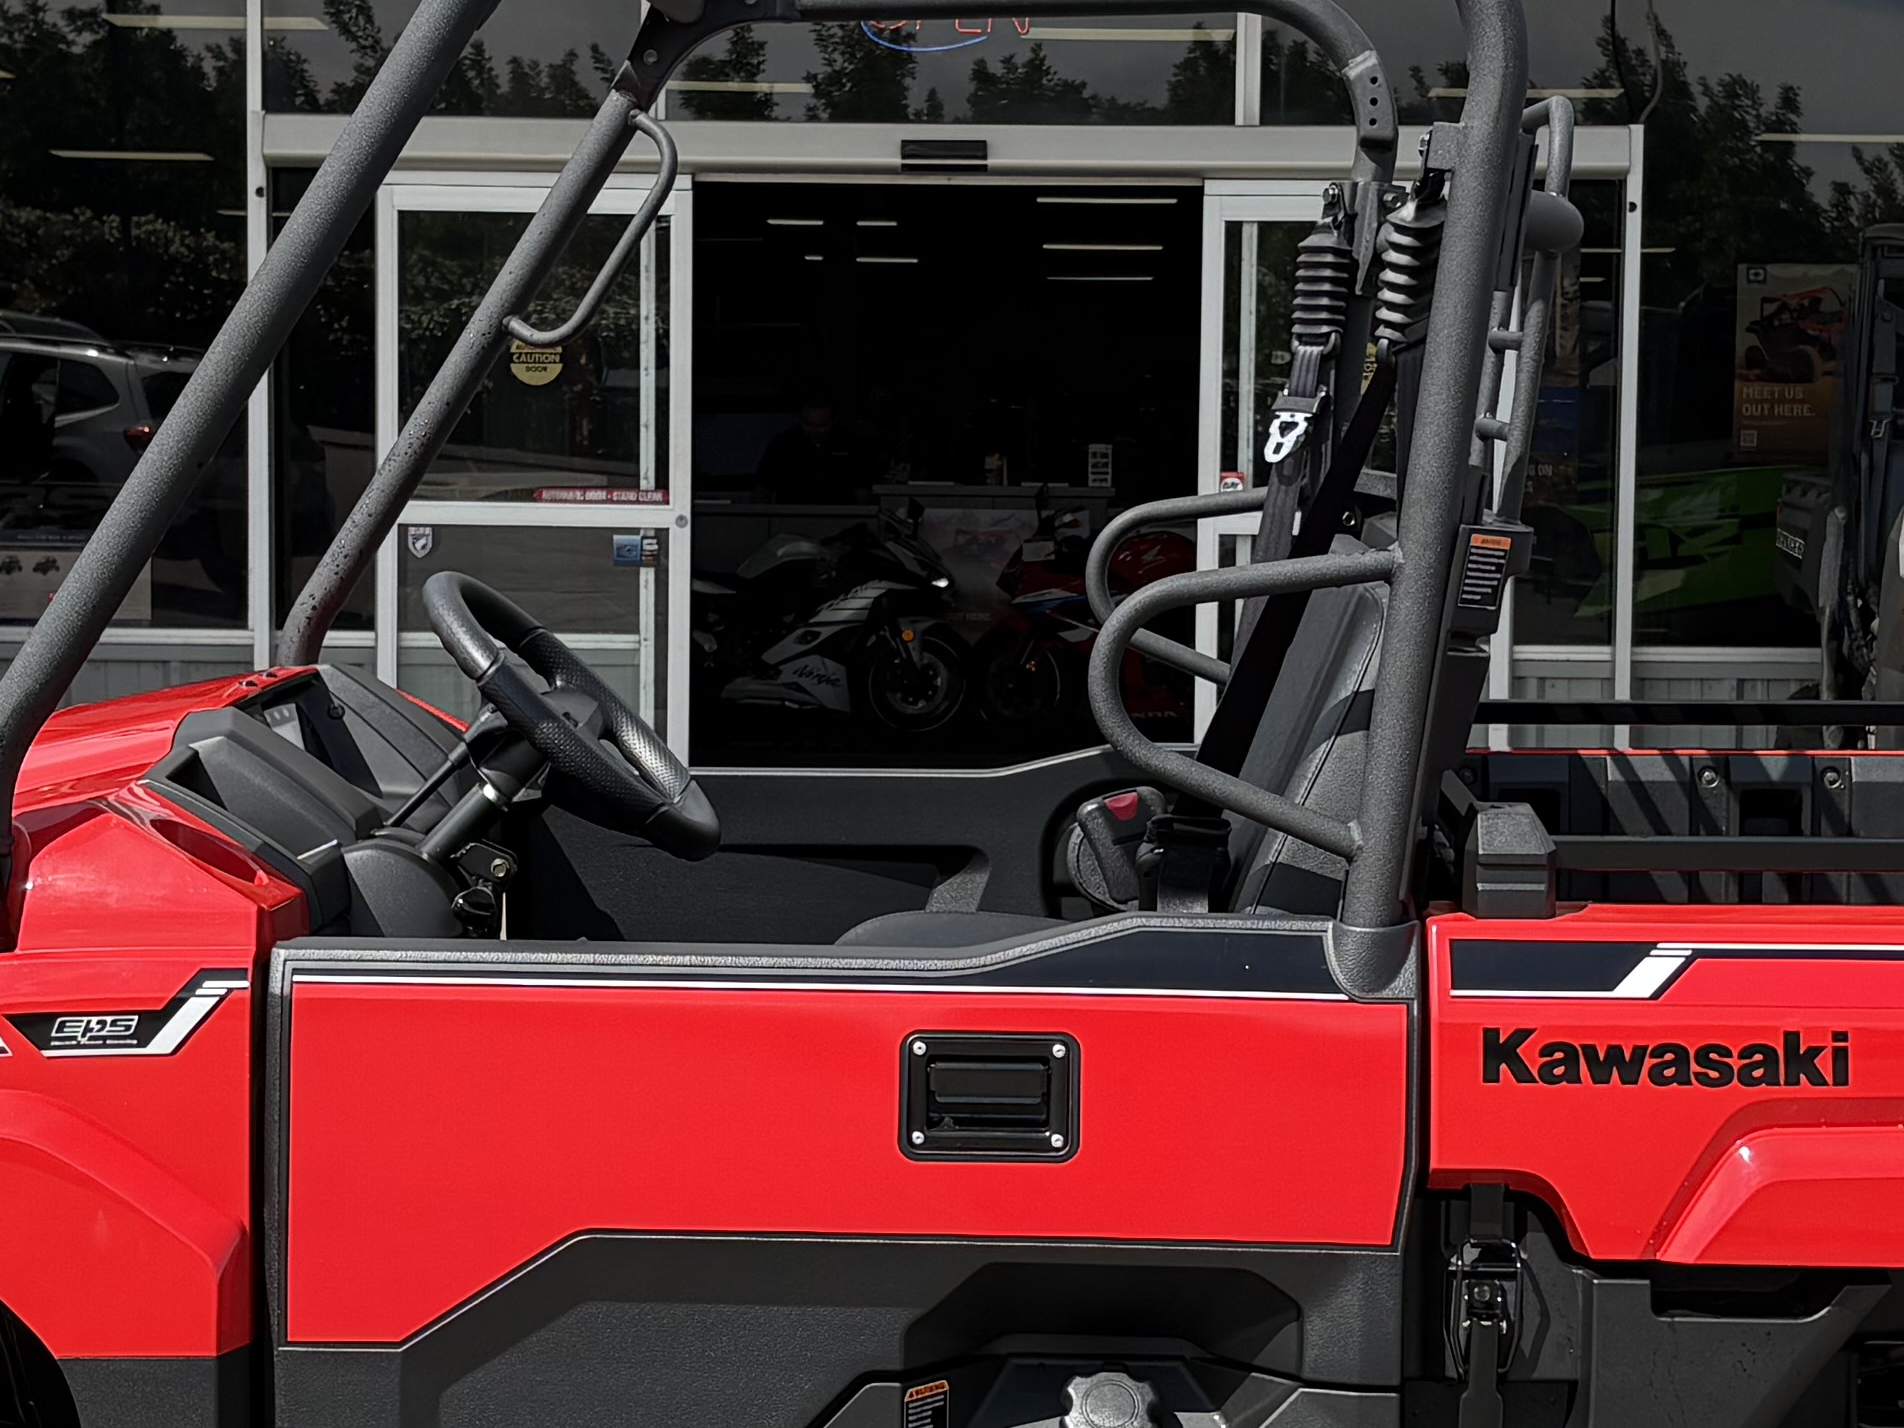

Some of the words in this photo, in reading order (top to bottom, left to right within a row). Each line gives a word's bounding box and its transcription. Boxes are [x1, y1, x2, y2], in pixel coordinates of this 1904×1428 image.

[512, 352, 561, 364] CAUTION
[1742, 386, 1783, 400] MEET
[1784, 386, 1804, 400] US
[1742, 403, 1769, 417] OUT
[1774, 403, 1817, 418] HERE.
[792, 663, 843, 688] Ninja
[1481, 1026, 1851, 1087] Kawasaki
